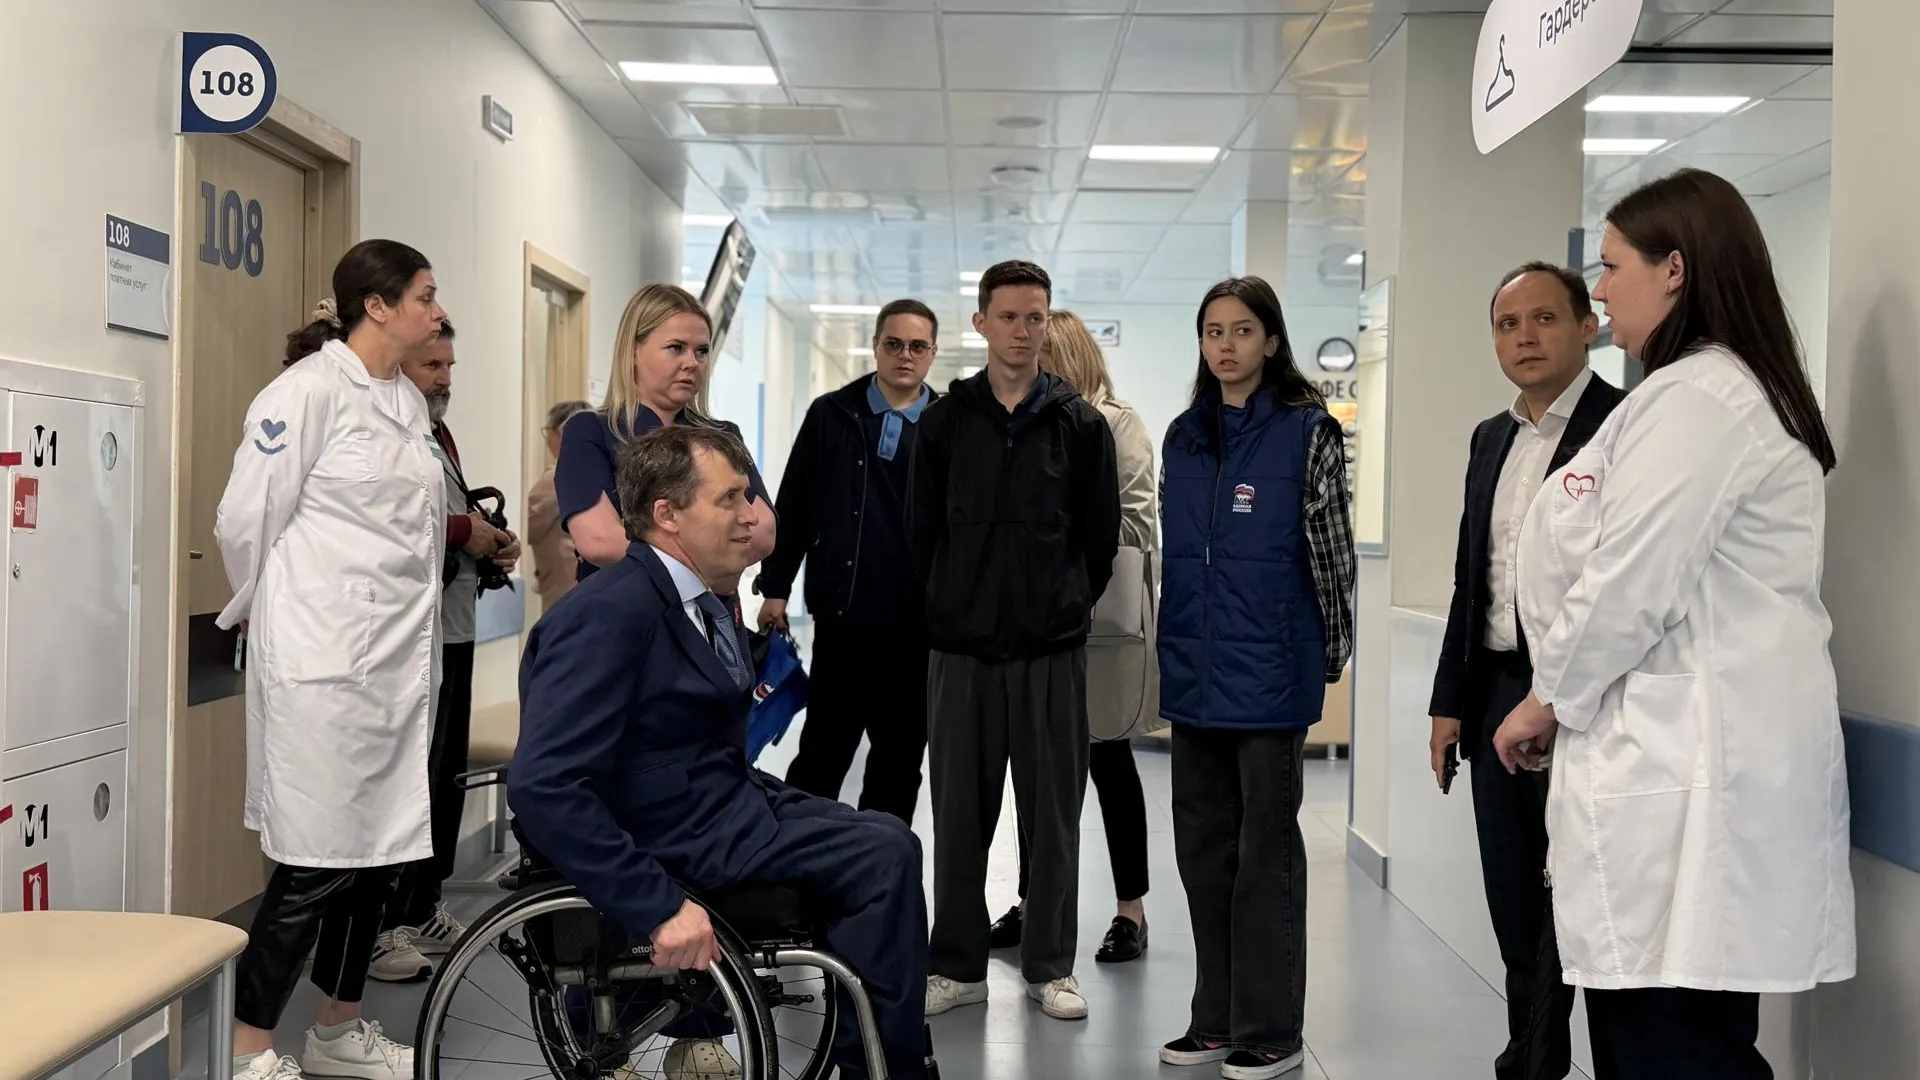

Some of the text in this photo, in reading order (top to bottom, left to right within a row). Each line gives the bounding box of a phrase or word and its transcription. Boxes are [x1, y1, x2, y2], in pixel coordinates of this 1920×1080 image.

[1538, 0, 1597, 48] Гардер
[200, 70, 254, 97] 108
[109, 220, 130, 248] 108
[199, 180, 264, 277] 108
[109, 257, 133, 273] Кабинет
[1308, 379, 1345, 399] ОФЕ
